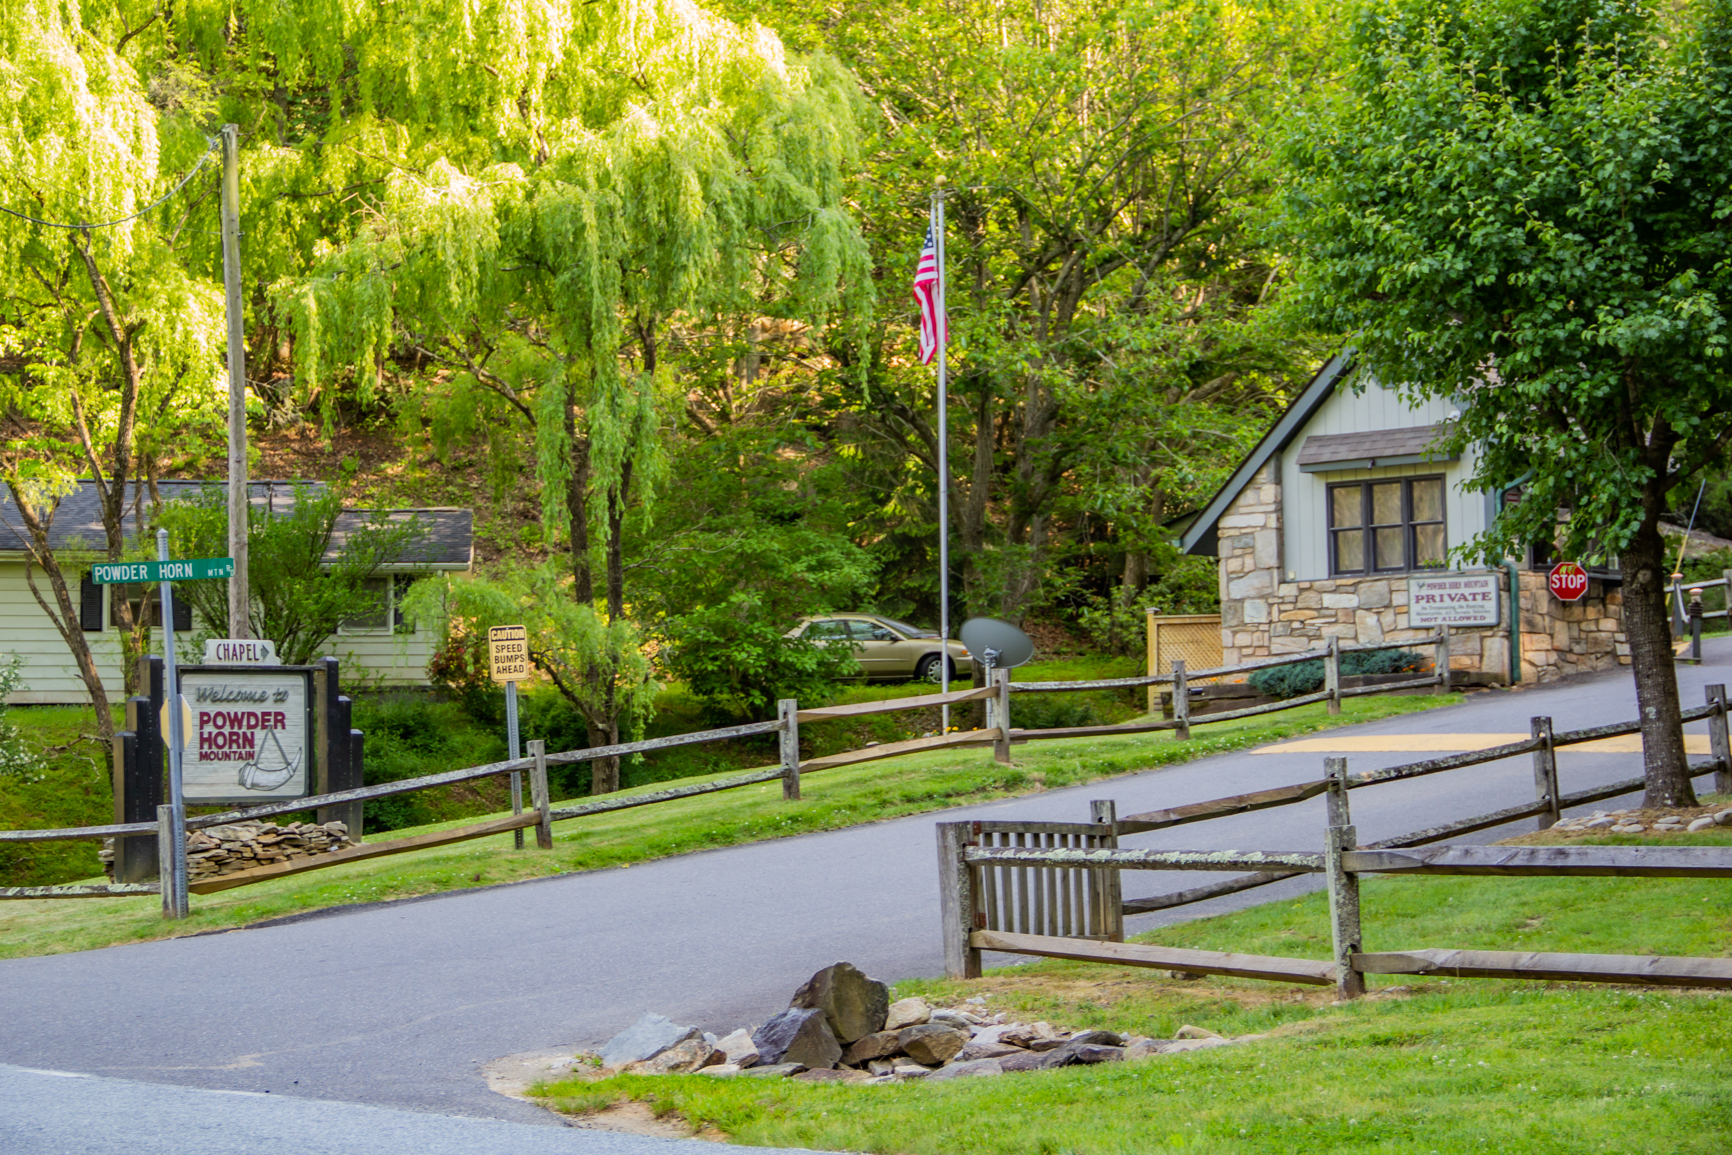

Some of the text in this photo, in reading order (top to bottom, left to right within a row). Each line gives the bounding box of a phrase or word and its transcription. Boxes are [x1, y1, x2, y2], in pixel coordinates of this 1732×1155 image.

[94, 565, 148, 582] POWDER
[158, 563, 193, 579] HORN
[207, 568, 224, 577] MTN
[1426, 580, 1489, 590] POWDER HORN MOUNTAIN
[1551, 574, 1586, 589] STOP
[1414, 592, 1492, 604] PRIVATE
[492, 628, 525, 640] CAUTION
[216, 643, 260, 661] CHAPEL
[495, 644, 522, 654] SPEED
[494, 654, 525, 664] BUMPS
[496, 665, 524, 674] AHEAD
[196, 684, 290, 703] Welcome to
[199, 711, 287, 730] POWDER
[199, 731, 256, 750] HORN
[199, 750, 256, 762] MOUNTAIN
